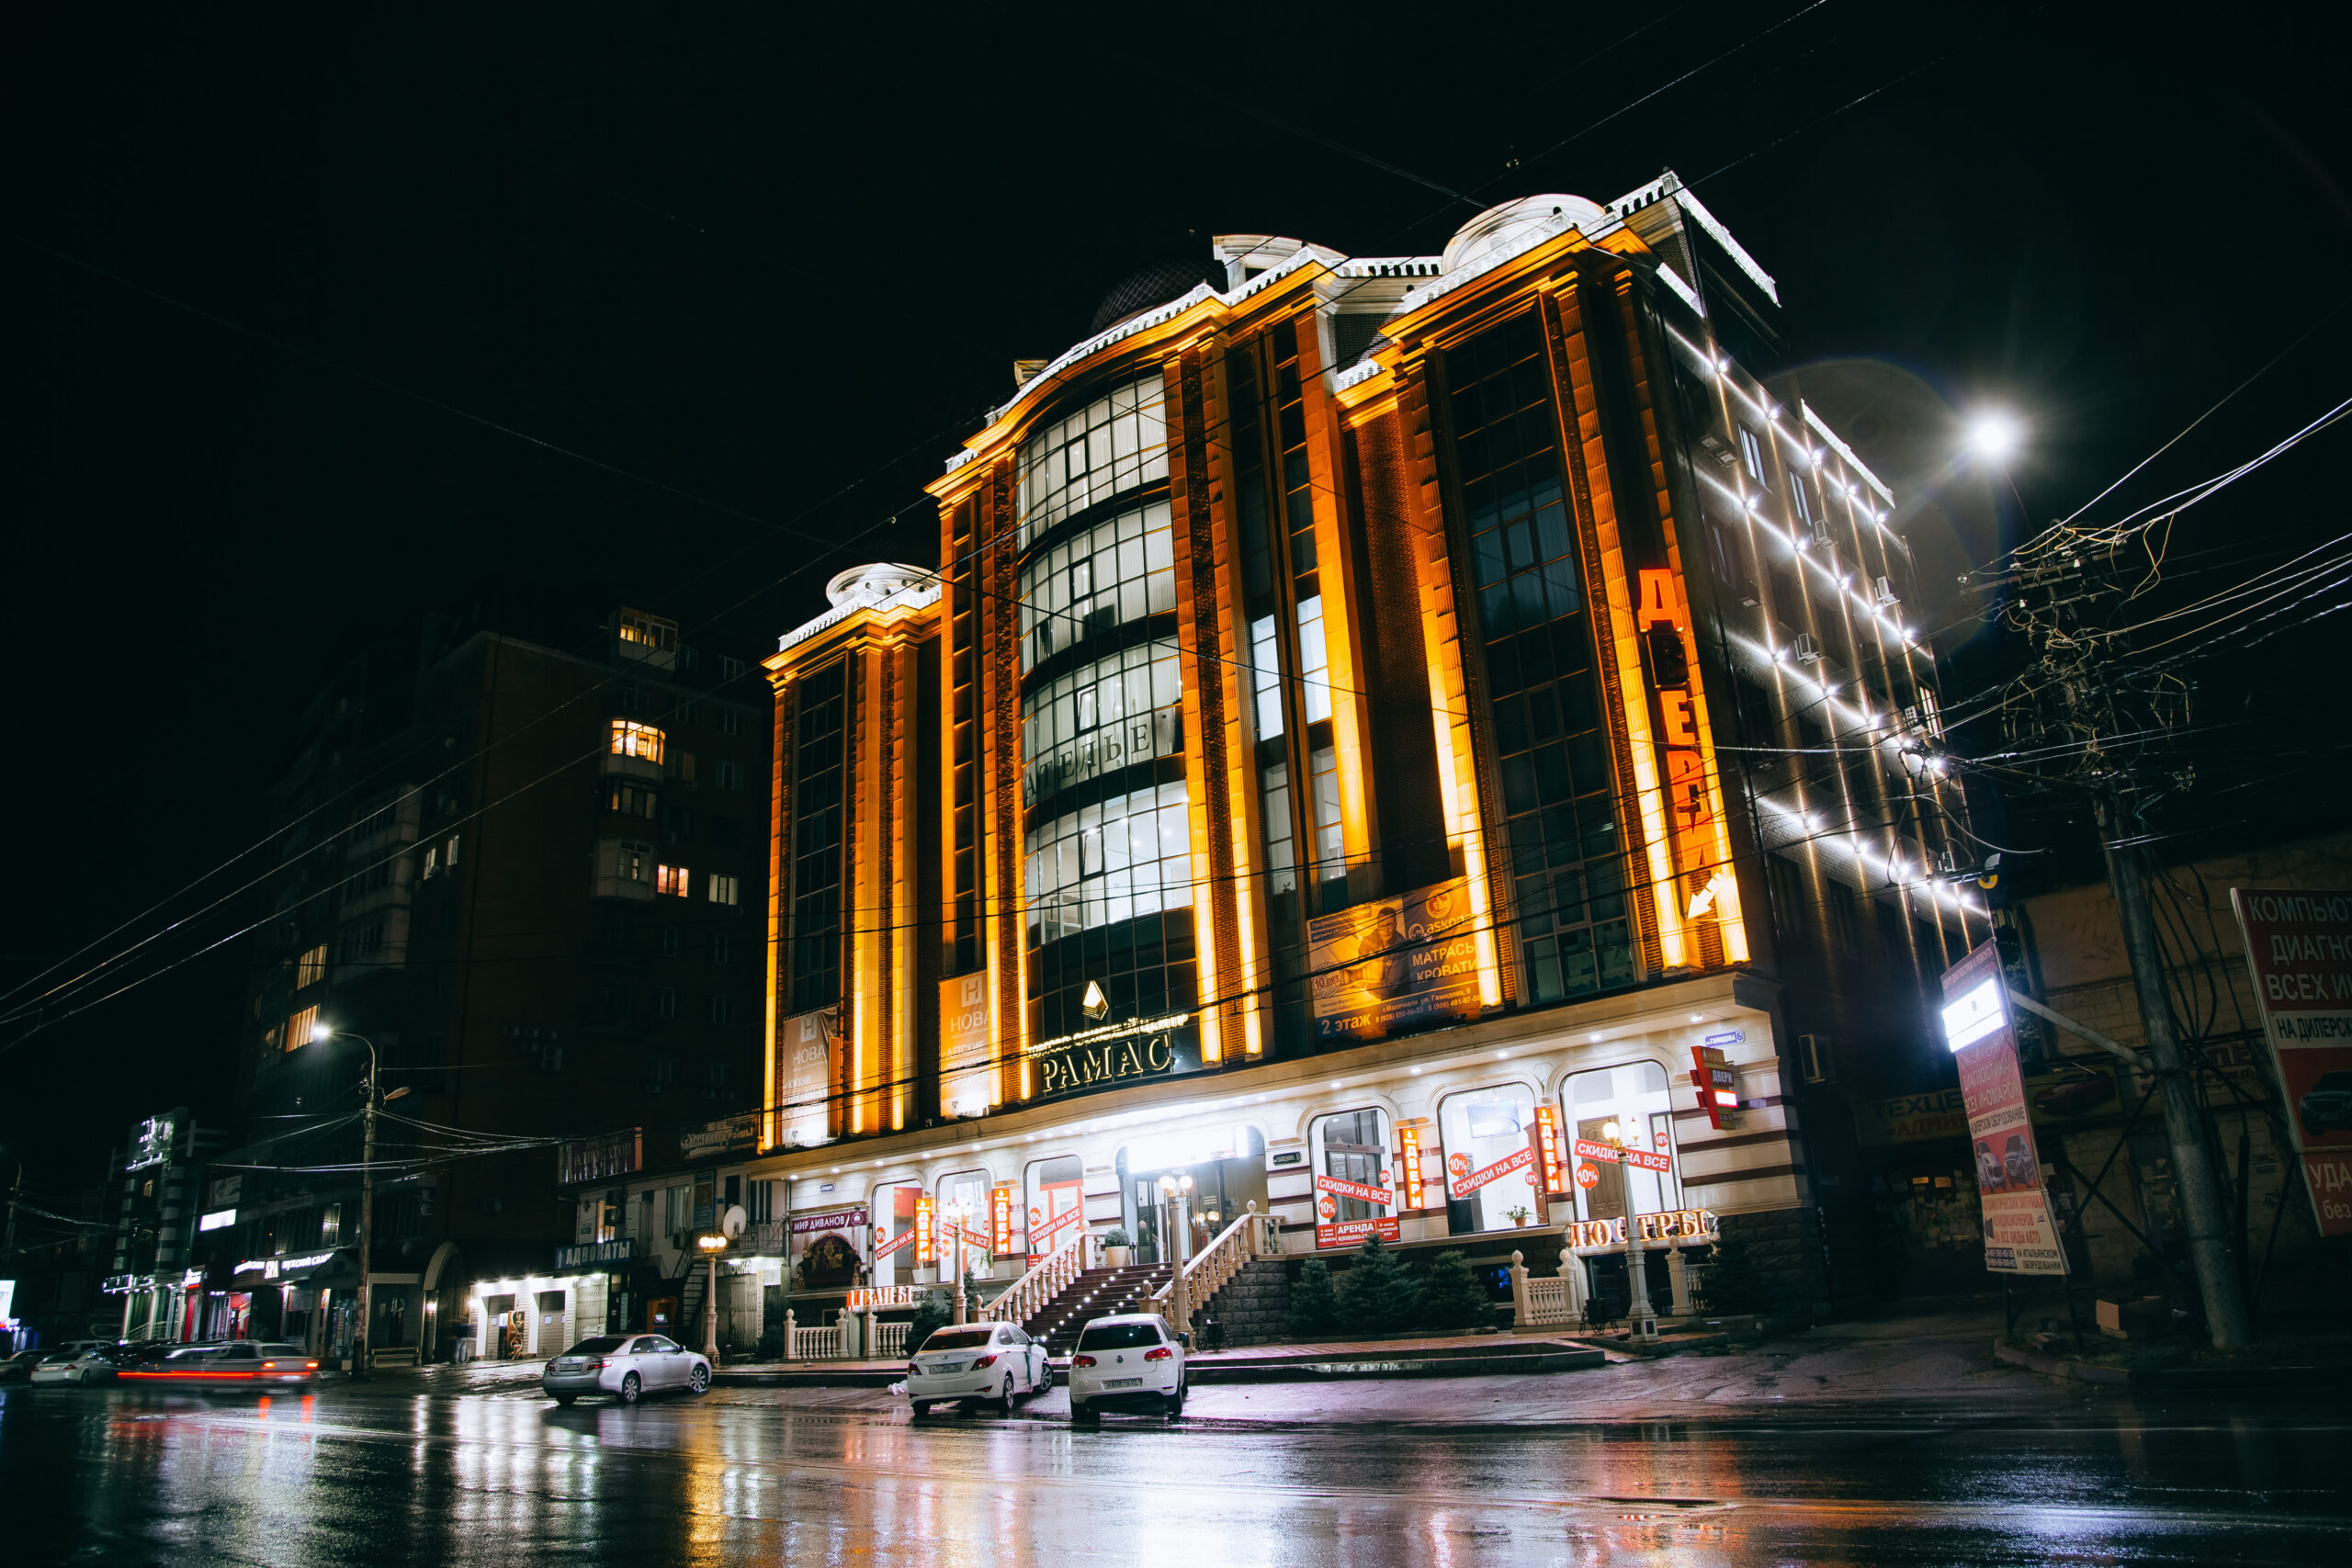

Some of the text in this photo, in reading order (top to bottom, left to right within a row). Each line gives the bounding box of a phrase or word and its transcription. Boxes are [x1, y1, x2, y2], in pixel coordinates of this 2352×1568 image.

[1025, 723, 1150, 799] АТЕЛЬЕ
[1315, 974, 1339, 988] 10 лет
[2265, 974, 2330, 1000] ВСЕХ
[1321, 1013, 1372, 1035] 2 этаж
[2277, 1017, 2297, 1039] НА
[793, 1043, 826, 1066] НОВА
[1713, 1069, 1733, 1084] ДВЕРИ
[1962, 1056, 2010, 1093] ДИАГНОСТИКА
[1979, 1079, 2021, 1111] ИНОМАРОК
[1656, 1135, 1668, 1145] 10%
[1449, 1157, 1467, 1171] 10%
[1542, 1124, 1559, 1191] ДВЕРИ
[1644, 1155, 1668, 1169] ВСЕ
[1406, 1145, 1422, 1208] ДВЕРИ
[1456, 1150, 1533, 1193] СКИДКИ НА ВСЕ
[1577, 1168, 1598, 1184] 10%
[1319, 1179, 1390, 1202] СКИДКИ НА ВСЕ
[1029, 1212, 1041, 1223] 10%
[1319, 1201, 1336, 1214] 10%
[2323, 1199, 2352, 1220] без
[794, 1215, 845, 1231] МИР ДИВАНОВ
[995, 1201, 1009, 1253] ДВЕРИ
[1030, 1209, 1081, 1242] СКИДКИ НА ВСЕ
[1338, 1223, 1374, 1235] АРЕНДА
[1569, 1208, 1710, 1248] ЛЮСТРЫ
[876, 1231, 915, 1258] СКИДКИ НА ВС
[917, 1211, 929, 1260] ДВЕРИ
[975, 1236, 988, 1247] ВСЕ
[2001, 1230, 2009, 1243] ВСЕ
[2025, 1230, 2041, 1245] АВТО
[566, 1241, 630, 1267] АДВОКАТЫ
[2016, 1249, 2022, 1258] НА
[2023, 1248, 2058, 1258] ИТАЛЬЯНСКОМ
